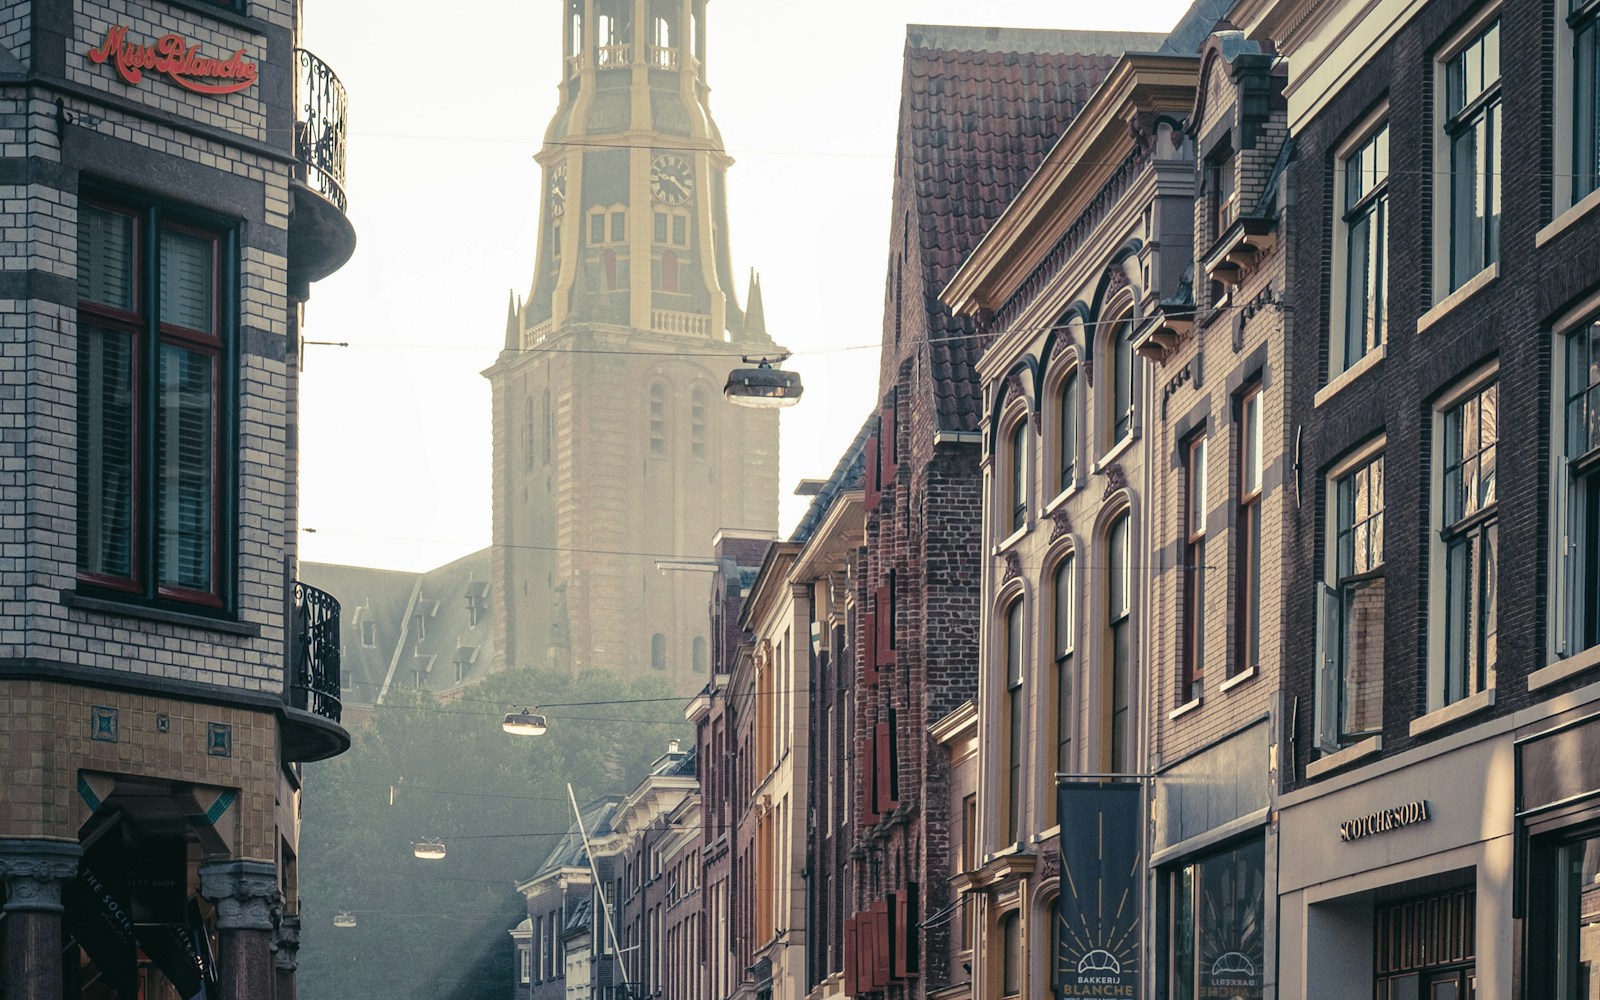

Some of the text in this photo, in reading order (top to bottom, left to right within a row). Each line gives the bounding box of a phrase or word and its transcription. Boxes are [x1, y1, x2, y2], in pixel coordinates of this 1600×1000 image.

[89, 25, 258, 95] Miss Blanche
[1339, 800, 1429, 842] SCOTCH&SODA
[82, 869, 104, 893] THE
[152, 879, 176, 888] SHOP
[1077, 976, 1120, 985] BAKKERIJ
[1064, 984, 1134, 996] BLANCHE
